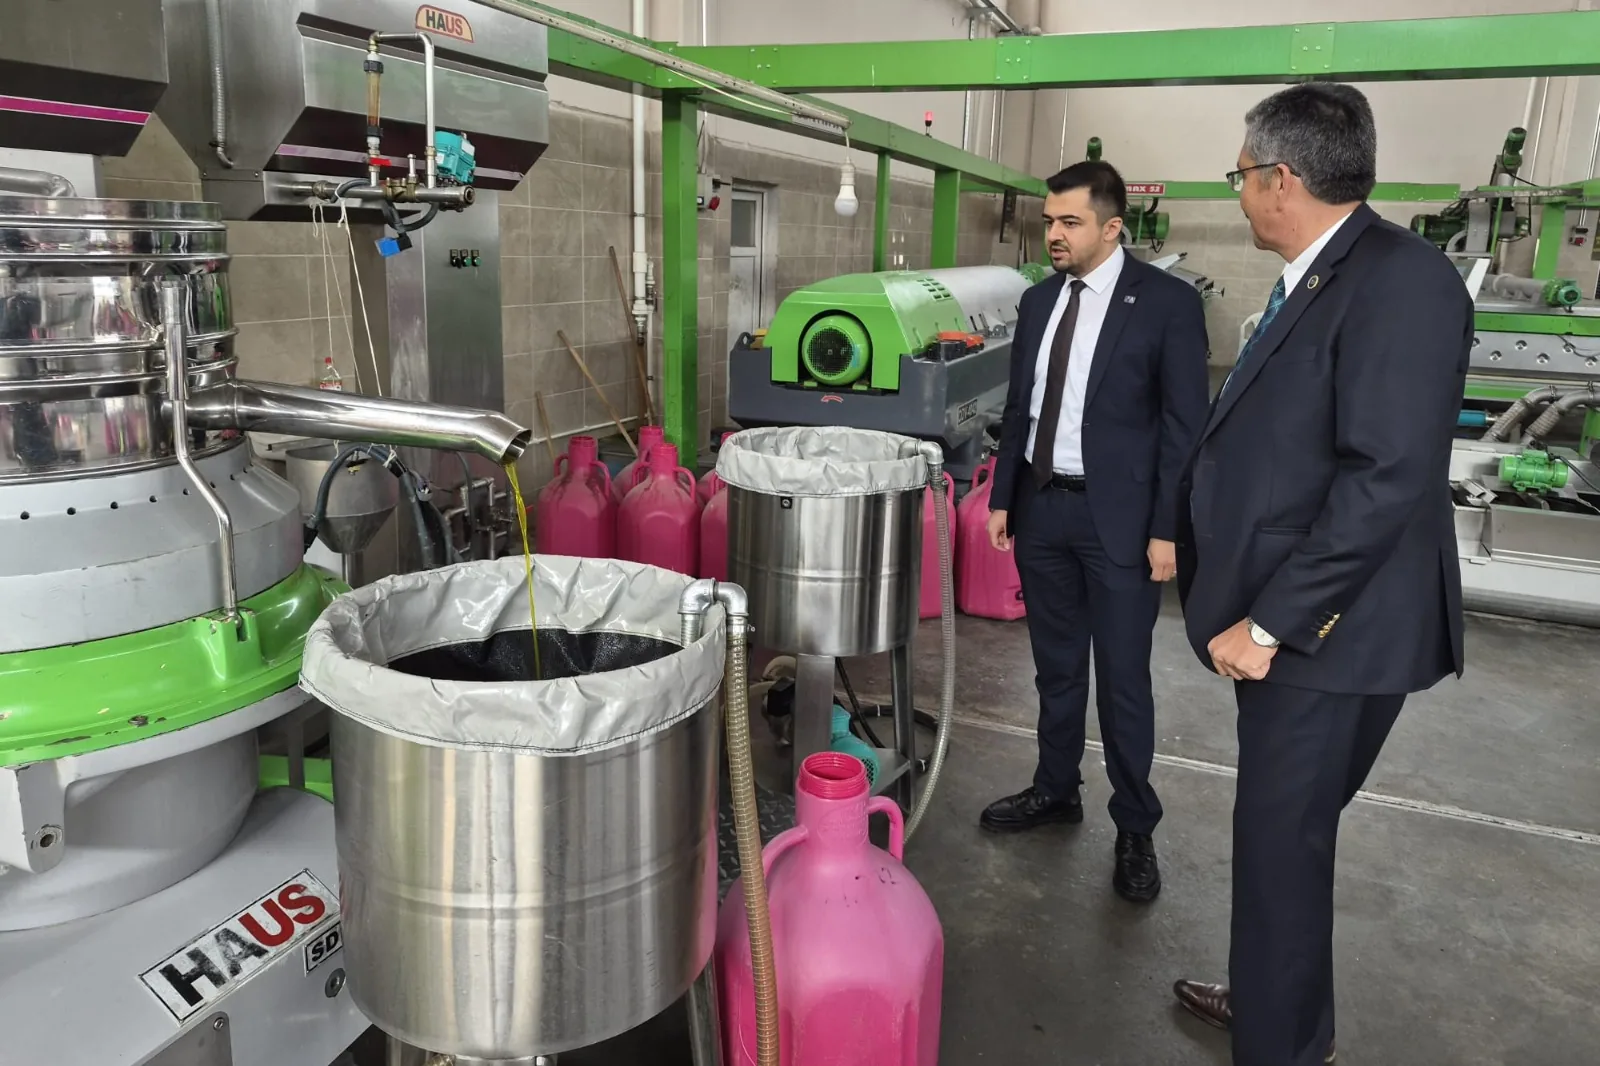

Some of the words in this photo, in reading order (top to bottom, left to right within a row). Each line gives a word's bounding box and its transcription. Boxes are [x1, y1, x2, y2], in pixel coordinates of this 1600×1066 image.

[426, 9, 463, 36] HAUS
[158, 883, 326, 1008] HAUS
[311, 930, 340, 963] SD
